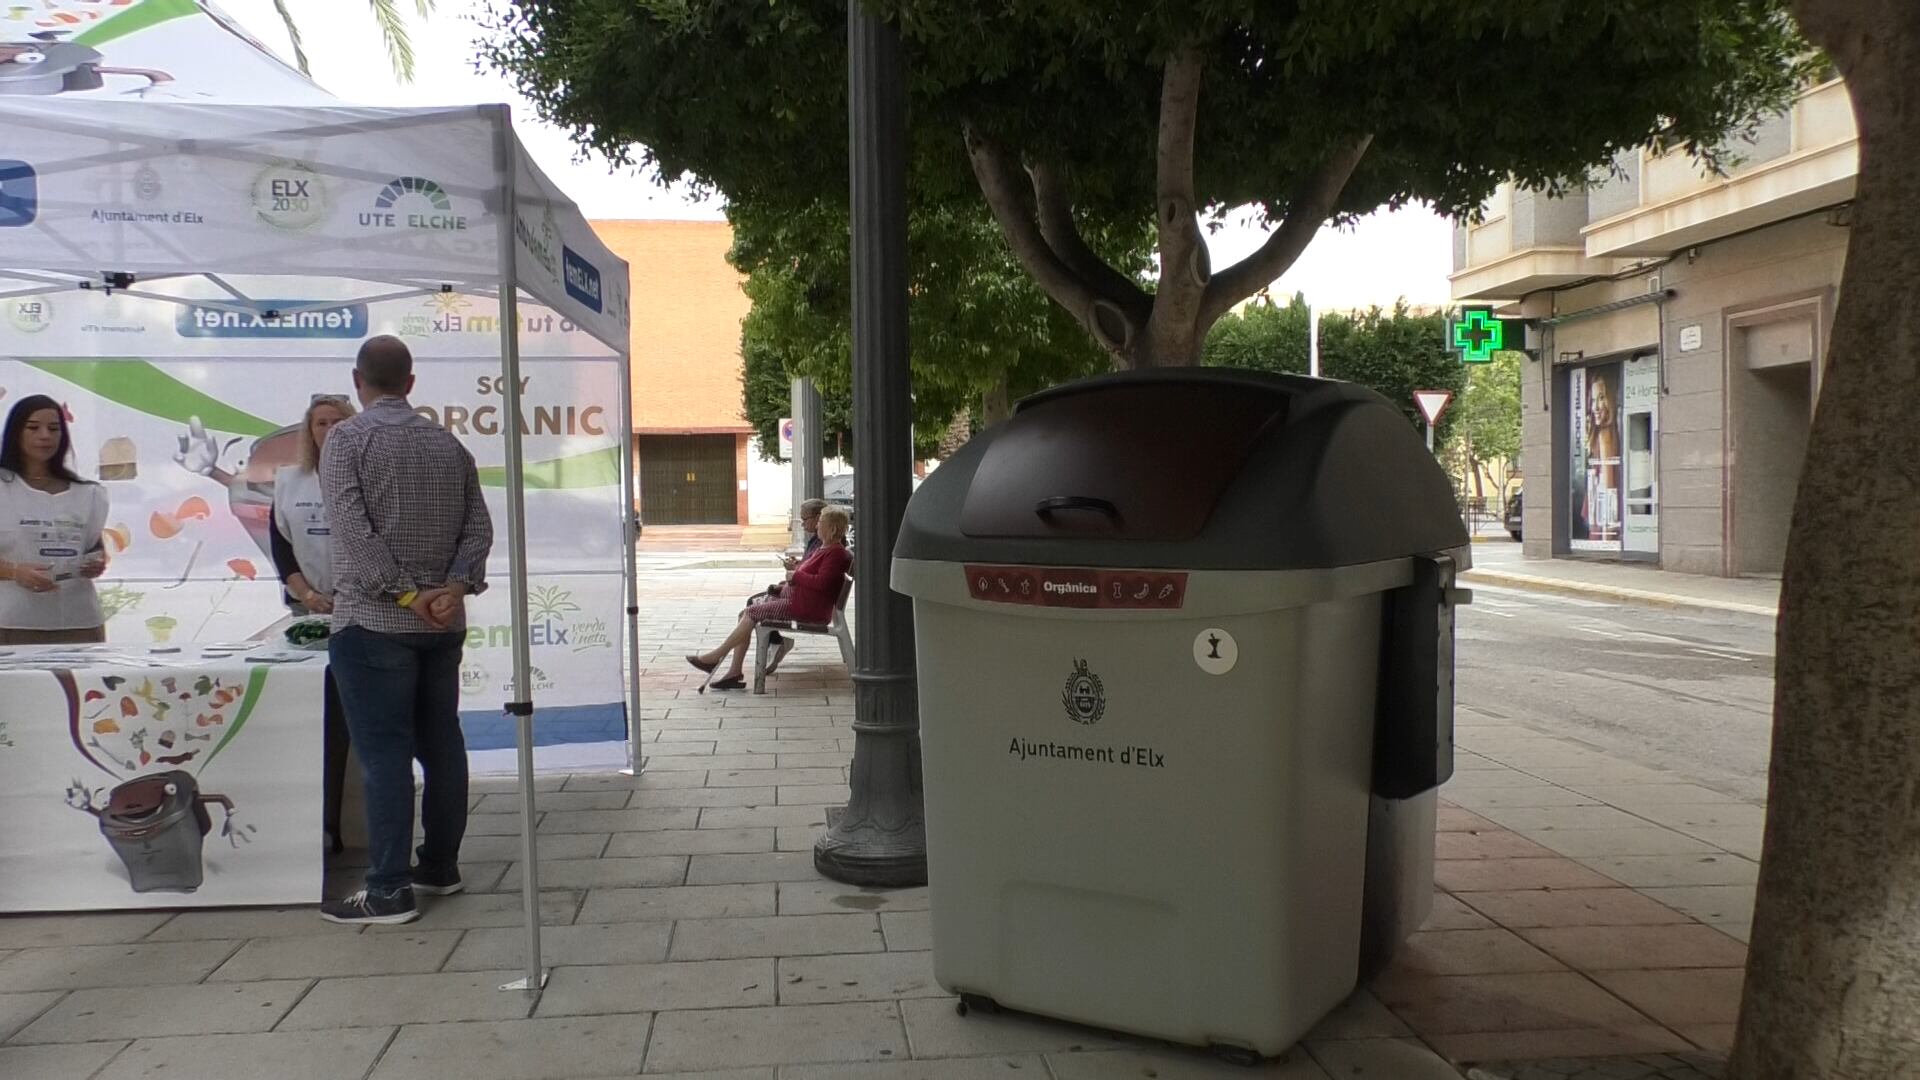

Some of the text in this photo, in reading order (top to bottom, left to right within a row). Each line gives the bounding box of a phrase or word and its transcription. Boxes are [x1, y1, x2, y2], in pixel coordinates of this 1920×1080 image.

[271, 179, 309, 198] ELX
[91, 209, 204, 224] Ajuntament d'Elx
[359, 213, 468, 230] UTE ELCHE
[1043, 580, 1098, 595] Orgánica
[529, 619, 569, 646] Elx
[1009, 737, 1165, 768] Ajuntament d'Elx
